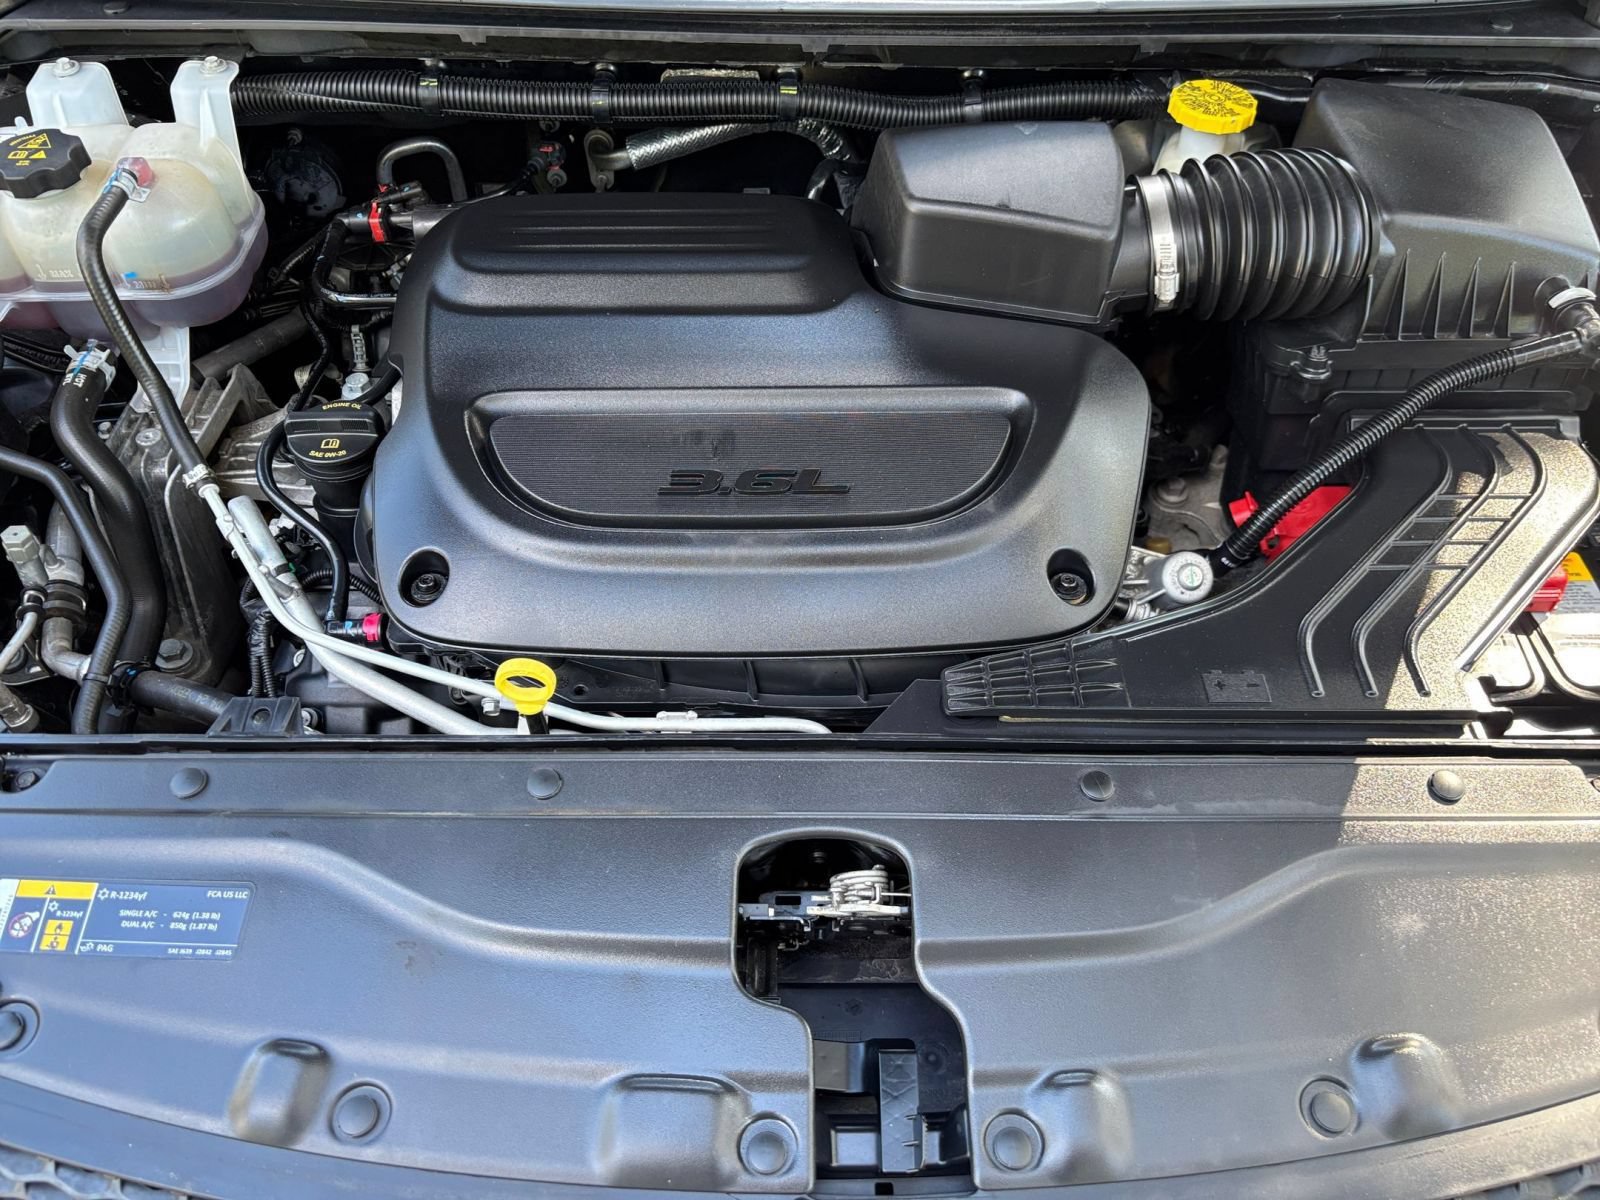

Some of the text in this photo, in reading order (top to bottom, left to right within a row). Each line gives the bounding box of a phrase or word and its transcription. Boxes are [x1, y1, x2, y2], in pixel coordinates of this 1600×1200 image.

[73, 373, 88, 388] HOT
[322, 402, 350, 410] ENGINE
[309, 450, 324, 458] SAE
[657, 467, 850, 496] 3.6L
[110, 890, 148, 901] R-1234yf
[207, 890, 249, 899] FCA US LLC
[56, 910, 84, 919] R-1234yf
[119, 909, 143, 917] SINGLE
[144, 909, 159, 918] A/C
[192, 911, 210, 920] (1.38
[210, 911, 221, 920] lb)
[121, 920, 140, 928] DUAL
[140, 920, 156, 929] A/C
[170, 921, 187, 931] 850g
[189, 922, 207, 931] (1.87
[207, 922, 218, 932] lb)
[96, 944, 114, 952] PAG
